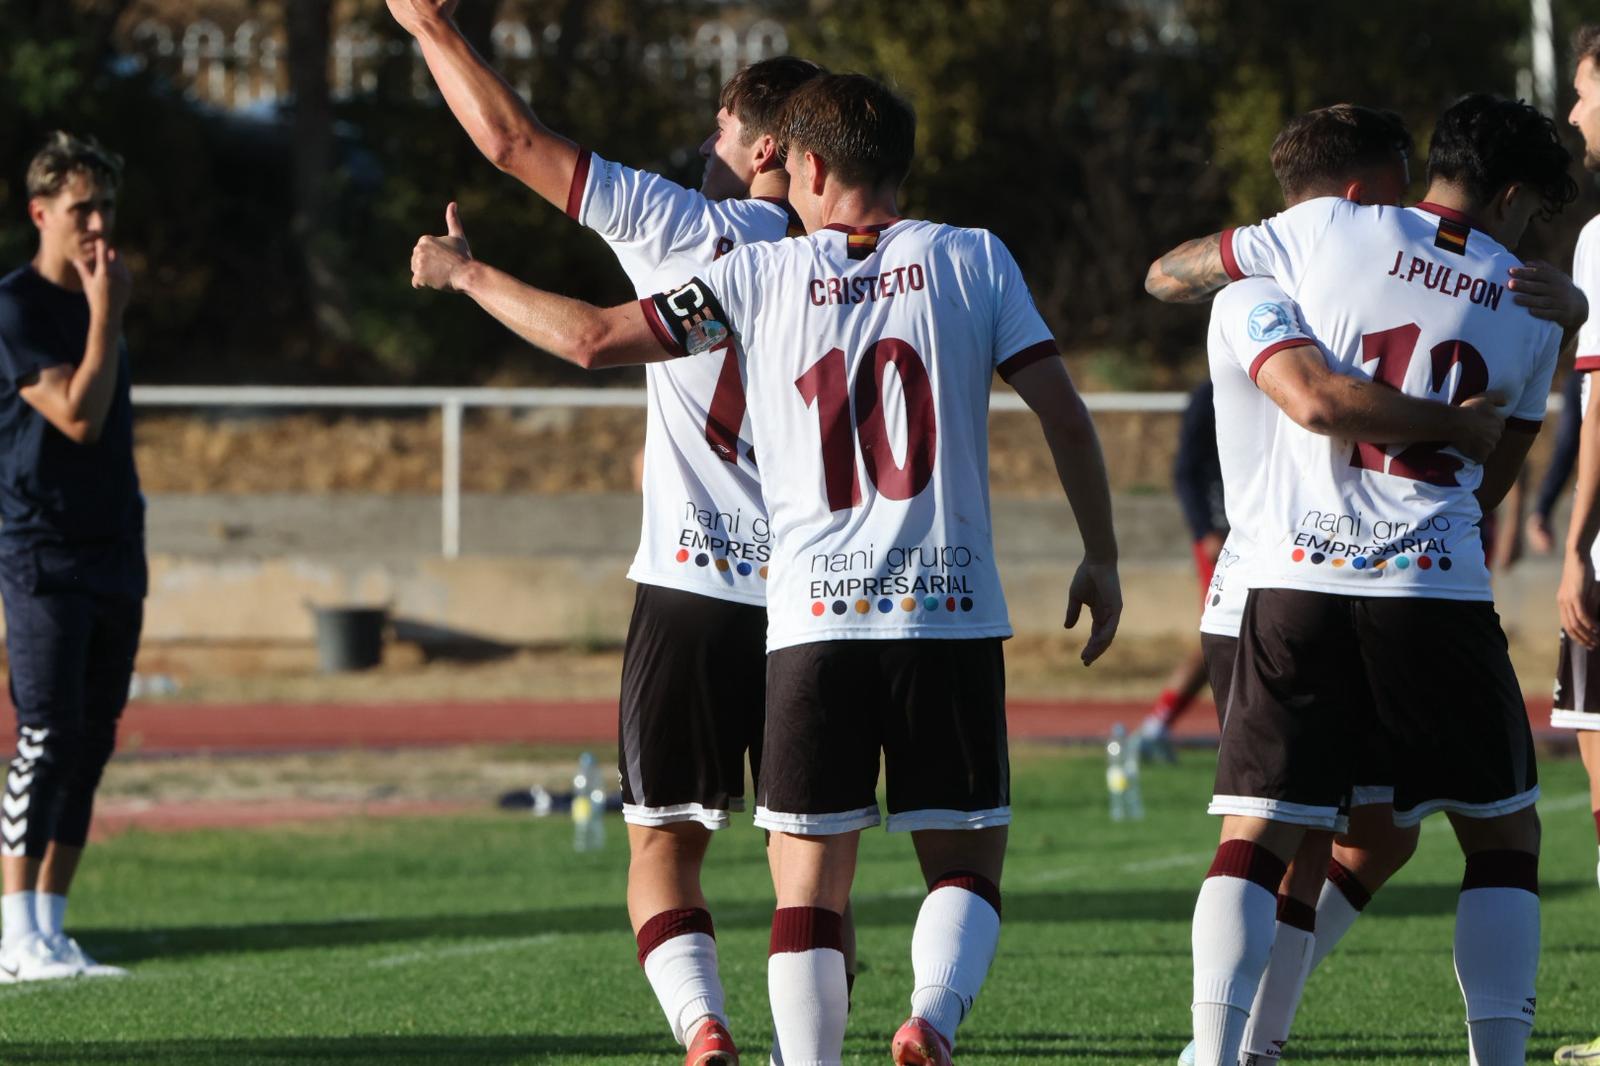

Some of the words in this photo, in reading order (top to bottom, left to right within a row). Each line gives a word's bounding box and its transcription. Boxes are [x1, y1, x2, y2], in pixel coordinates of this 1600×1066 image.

[808, 264, 925, 306] CRISTETO
[1388, 250, 1504, 312] J.PULPON
[1348, 322, 1489, 487] 12
[794, 337, 937, 513] 10
[685, 502, 740, 534] nani
[1302, 509, 1363, 537] nani
[679, 529, 771, 563] EMPRES
[811, 543, 873, 573] nani
[886, 544, 971, 575] grupo
[810, 575, 973, 599] EMPRESARIAL
